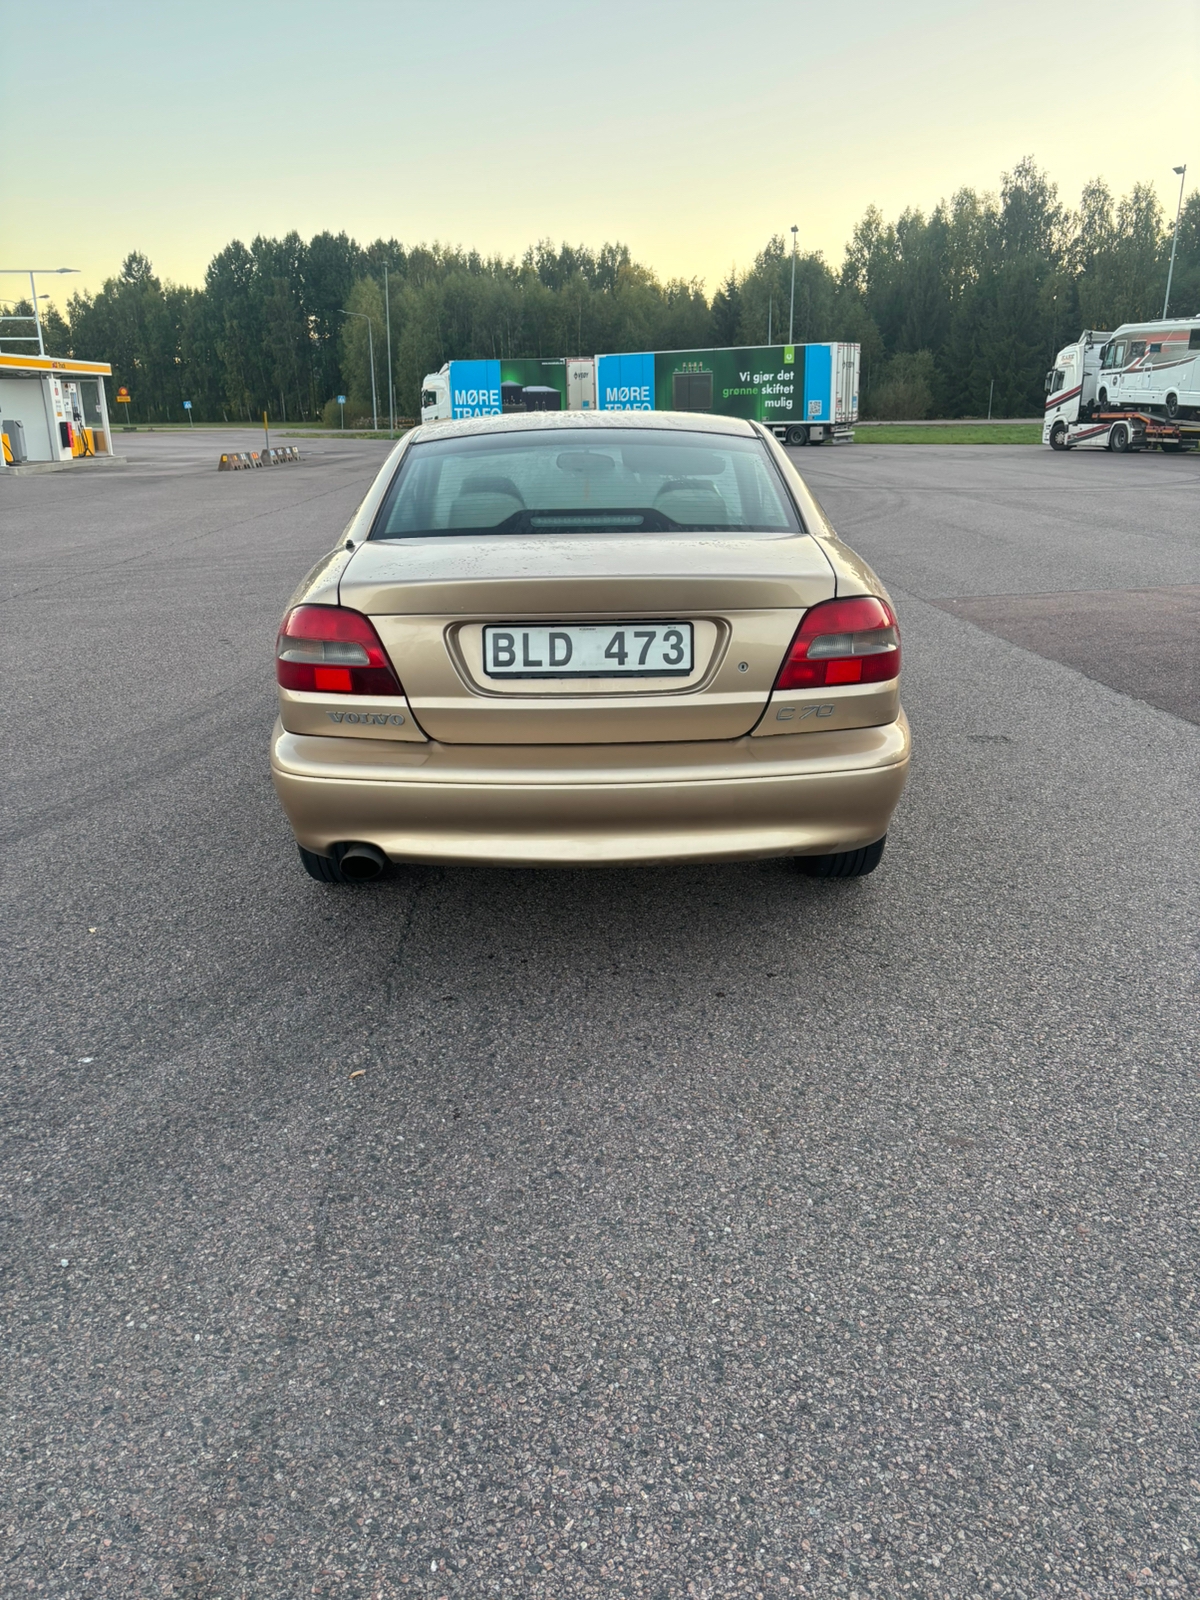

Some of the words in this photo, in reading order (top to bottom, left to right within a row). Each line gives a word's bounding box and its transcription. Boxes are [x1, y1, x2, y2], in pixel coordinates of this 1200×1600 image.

[739, 371, 751, 382] Vi
[753, 371, 774, 384] gjør
[777, 369, 795, 381] det
[454, 389, 500, 406] MØRE
[606, 386, 651, 402] MØRE
[722, 387, 759, 398] grønne
[761, 383, 795, 395] skiftet
[764, 396, 794, 410] mulig
[492, 632, 573, 668] BLD
[604, 629, 685, 666] 473
[325, 710, 406, 726] VOLVO
[776, 706, 796, 721] C
[799, 703, 835, 720] 70
